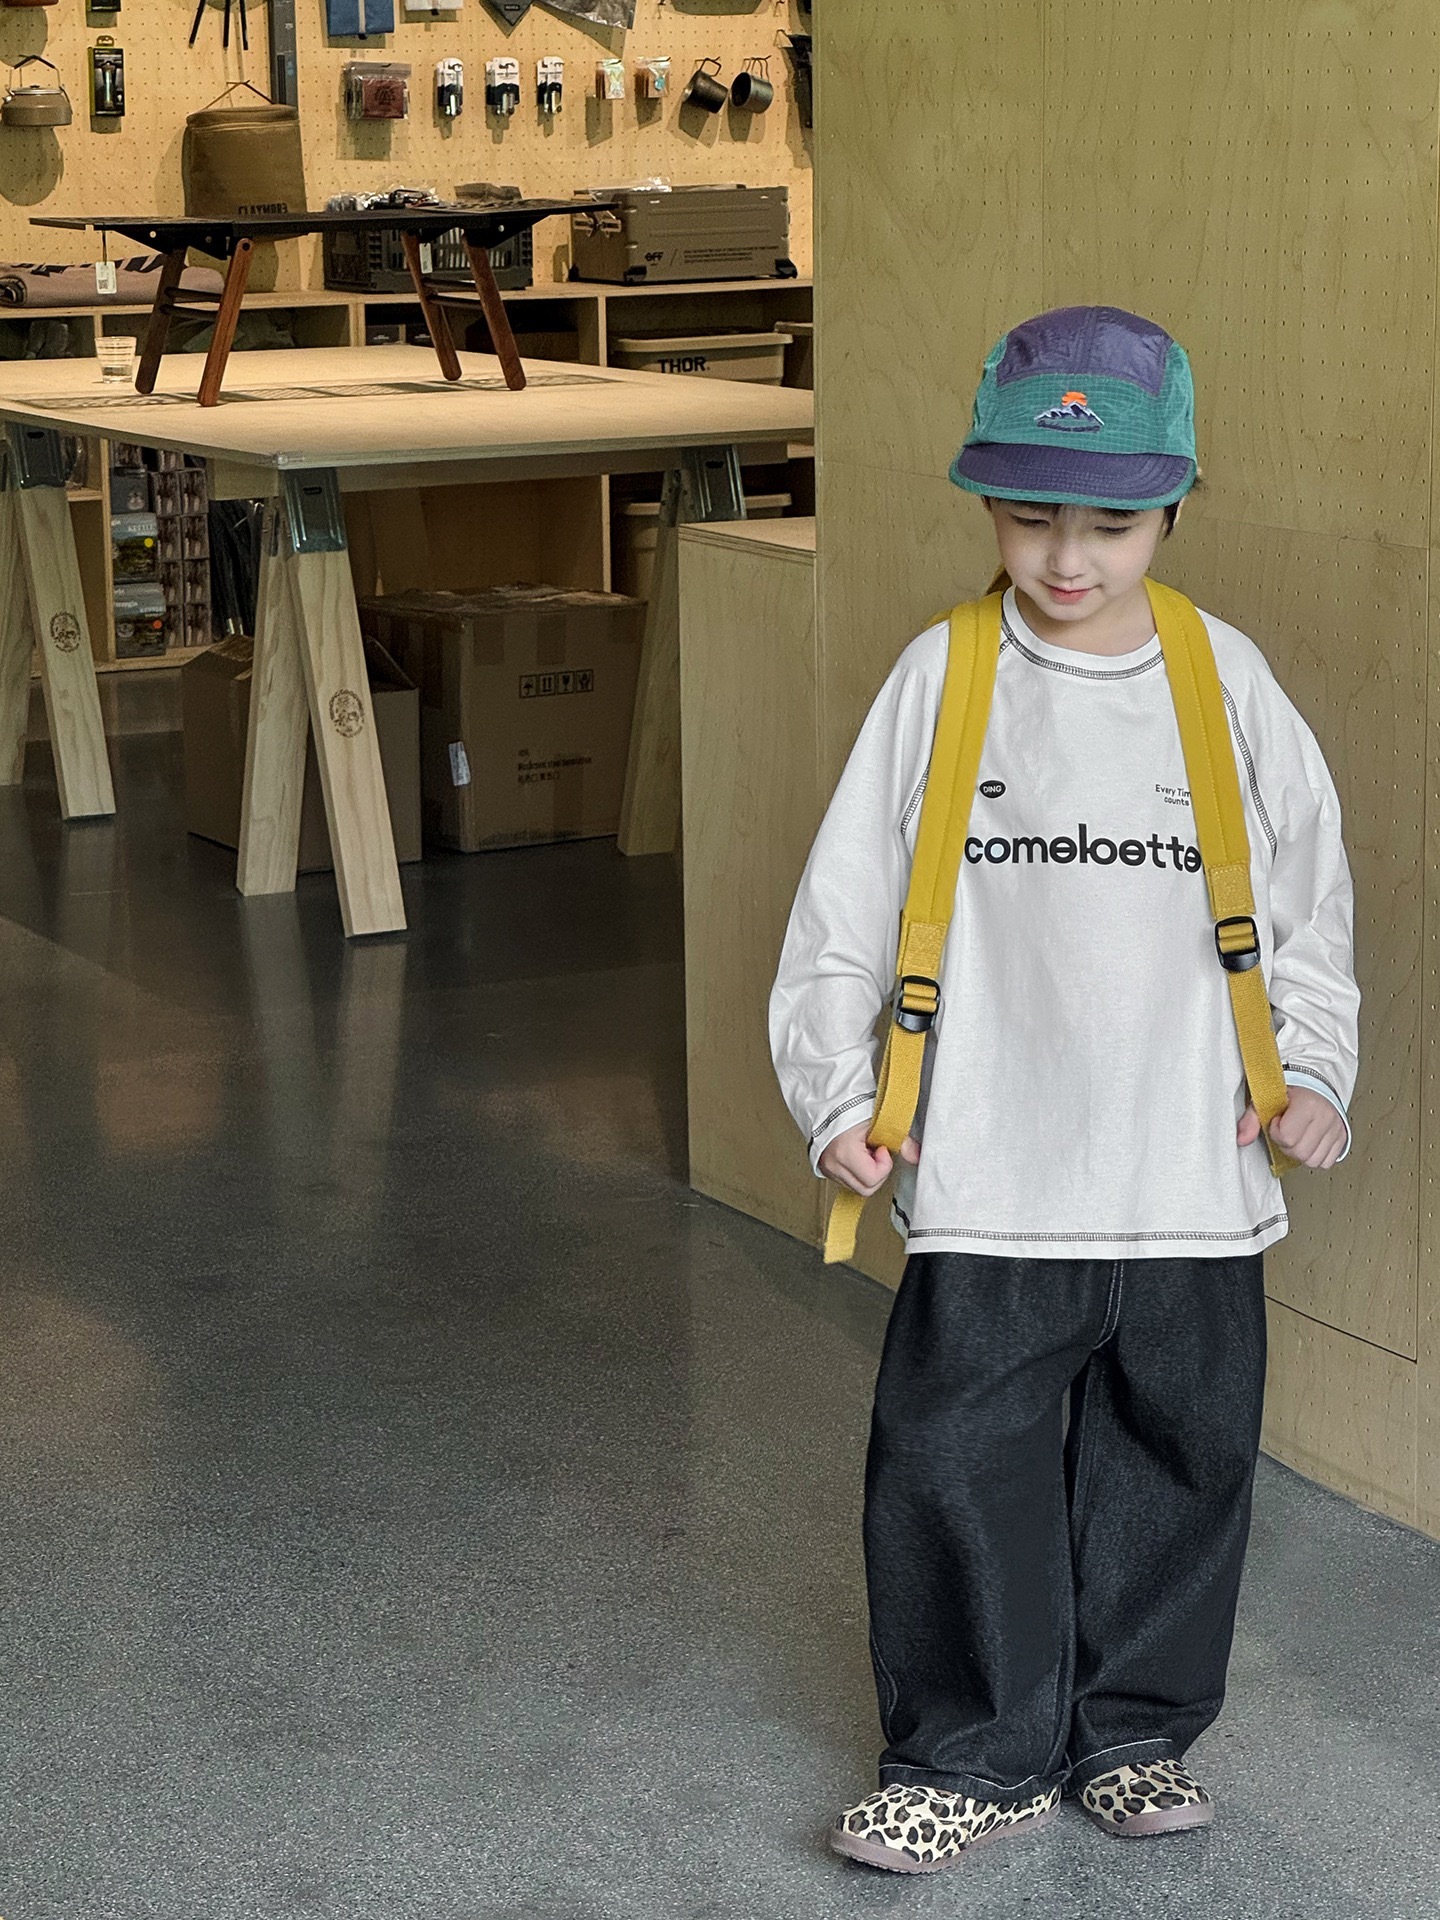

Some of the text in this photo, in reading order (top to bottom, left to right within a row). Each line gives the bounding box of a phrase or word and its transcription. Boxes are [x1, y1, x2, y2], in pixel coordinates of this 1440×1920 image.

[657, 356, 706, 374] THOR
[982, 785, 1002, 793] DING
[1155, 783, 1192, 797] Every Tim
[1163, 796, 1190, 807] counts
